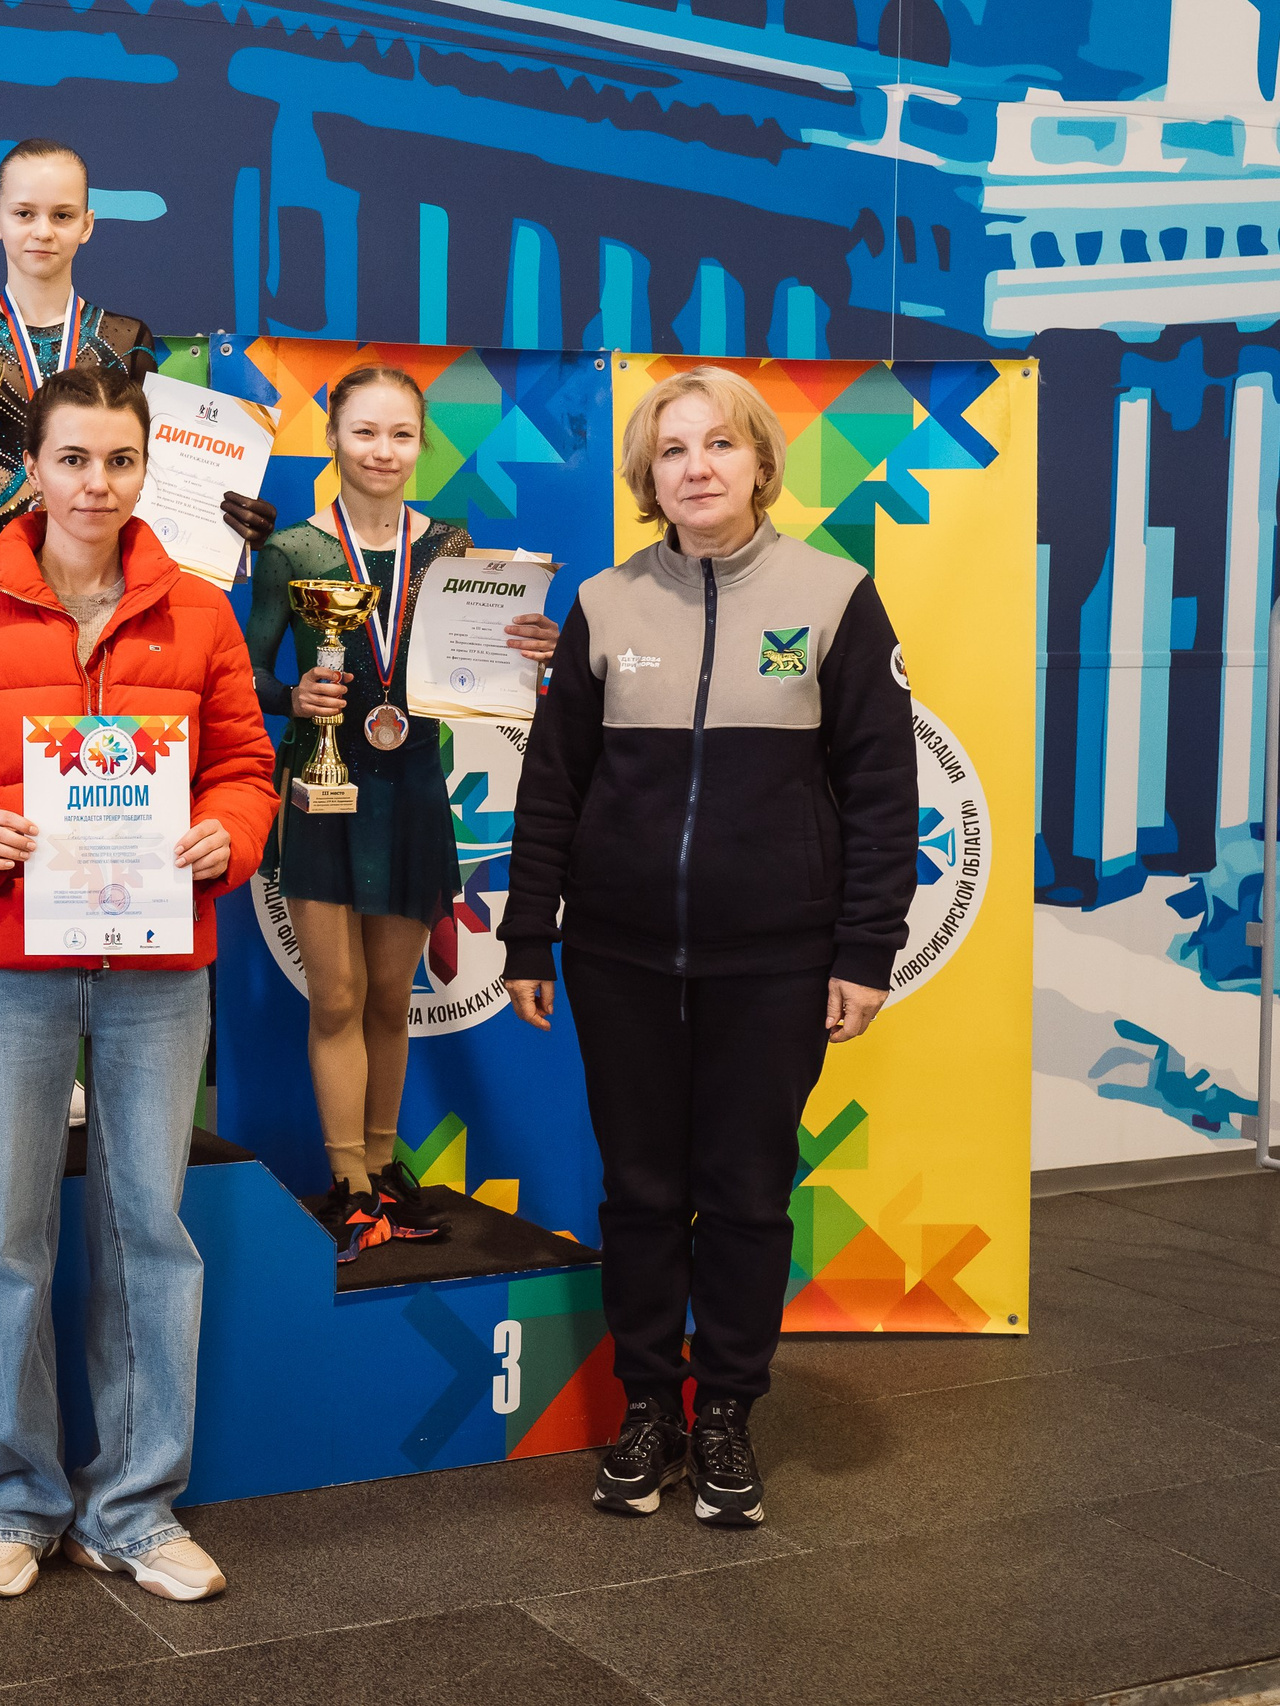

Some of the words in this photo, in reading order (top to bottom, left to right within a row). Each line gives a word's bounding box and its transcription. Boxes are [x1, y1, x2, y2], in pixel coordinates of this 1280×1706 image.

[155, 424, 245, 460] ДИПЛОМ
[442, 578, 526, 598] ДИПЛОМ
[67, 784, 150, 810] ДИПЛОМ
[893, 880, 976, 988] НОВОСИБИРСКОЙ
[961, 799, 981, 878] ОБЛАСТИ»
[427, 987, 494, 1025] КОНЬКАХ
[492, 1319, 522, 1415] 3
